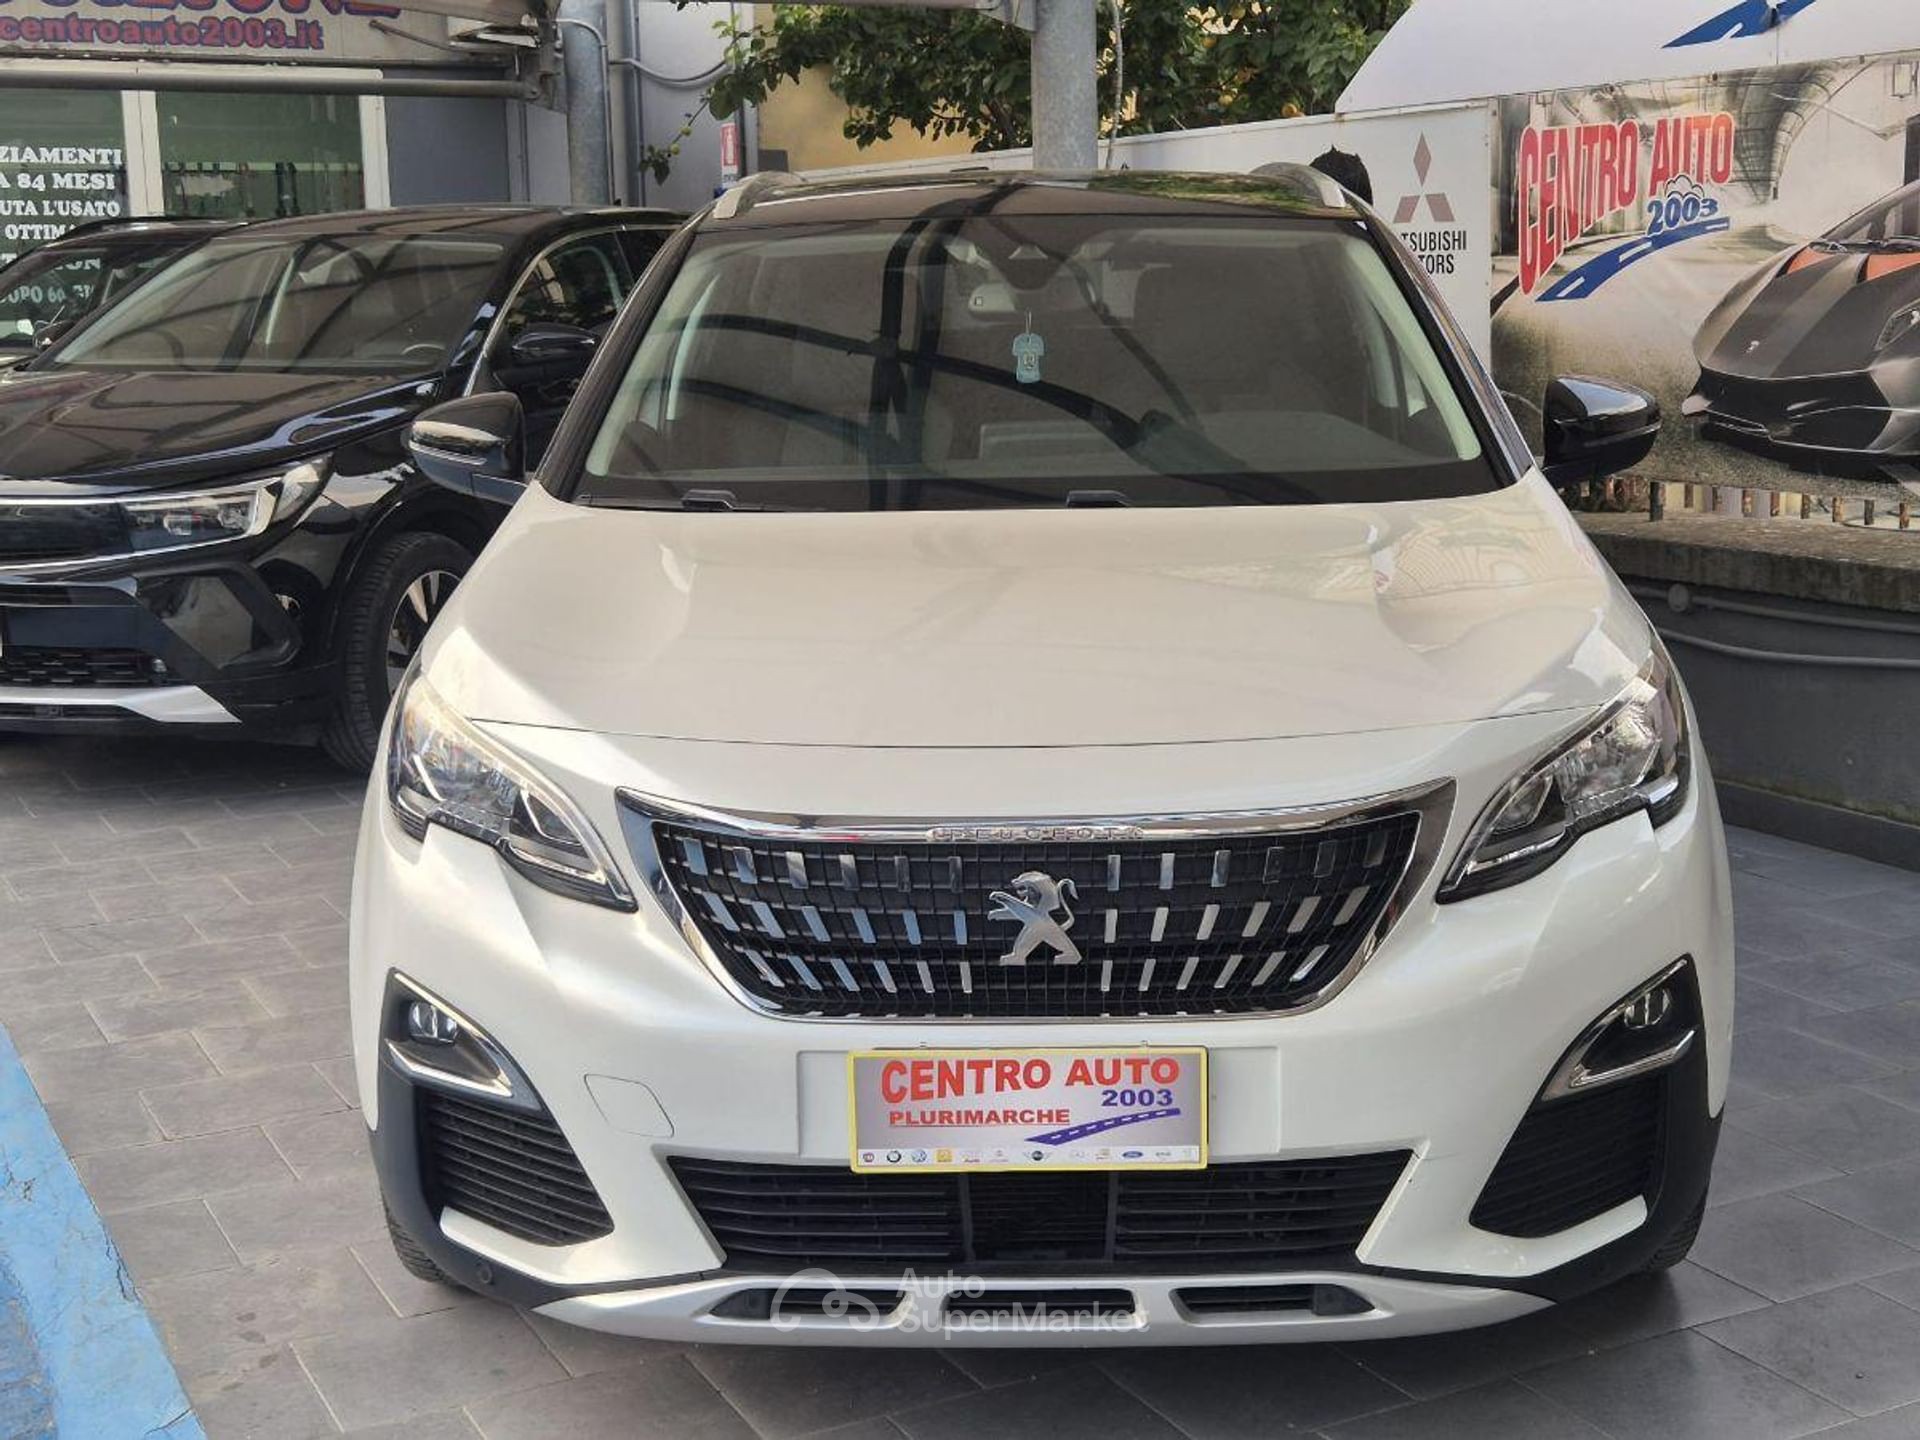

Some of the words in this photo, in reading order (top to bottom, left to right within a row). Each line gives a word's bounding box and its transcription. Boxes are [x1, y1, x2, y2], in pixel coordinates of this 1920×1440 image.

[18, 173, 46, 191] 84
[53, 173, 115, 190] MESI
[43, 200, 120, 217] L'USATO
[1519, 121, 1639, 296] CENTRO
[1650, 114, 1733, 196] AUTO
[1647, 196, 1718, 235] 2003
[881, 1060, 1051, 1104] CENTRO
[1065, 1057, 1180, 1088] AUTO
[1101, 1089, 1173, 1107] 2003
[889, 1109, 1071, 1126] PLURIMARCHE
